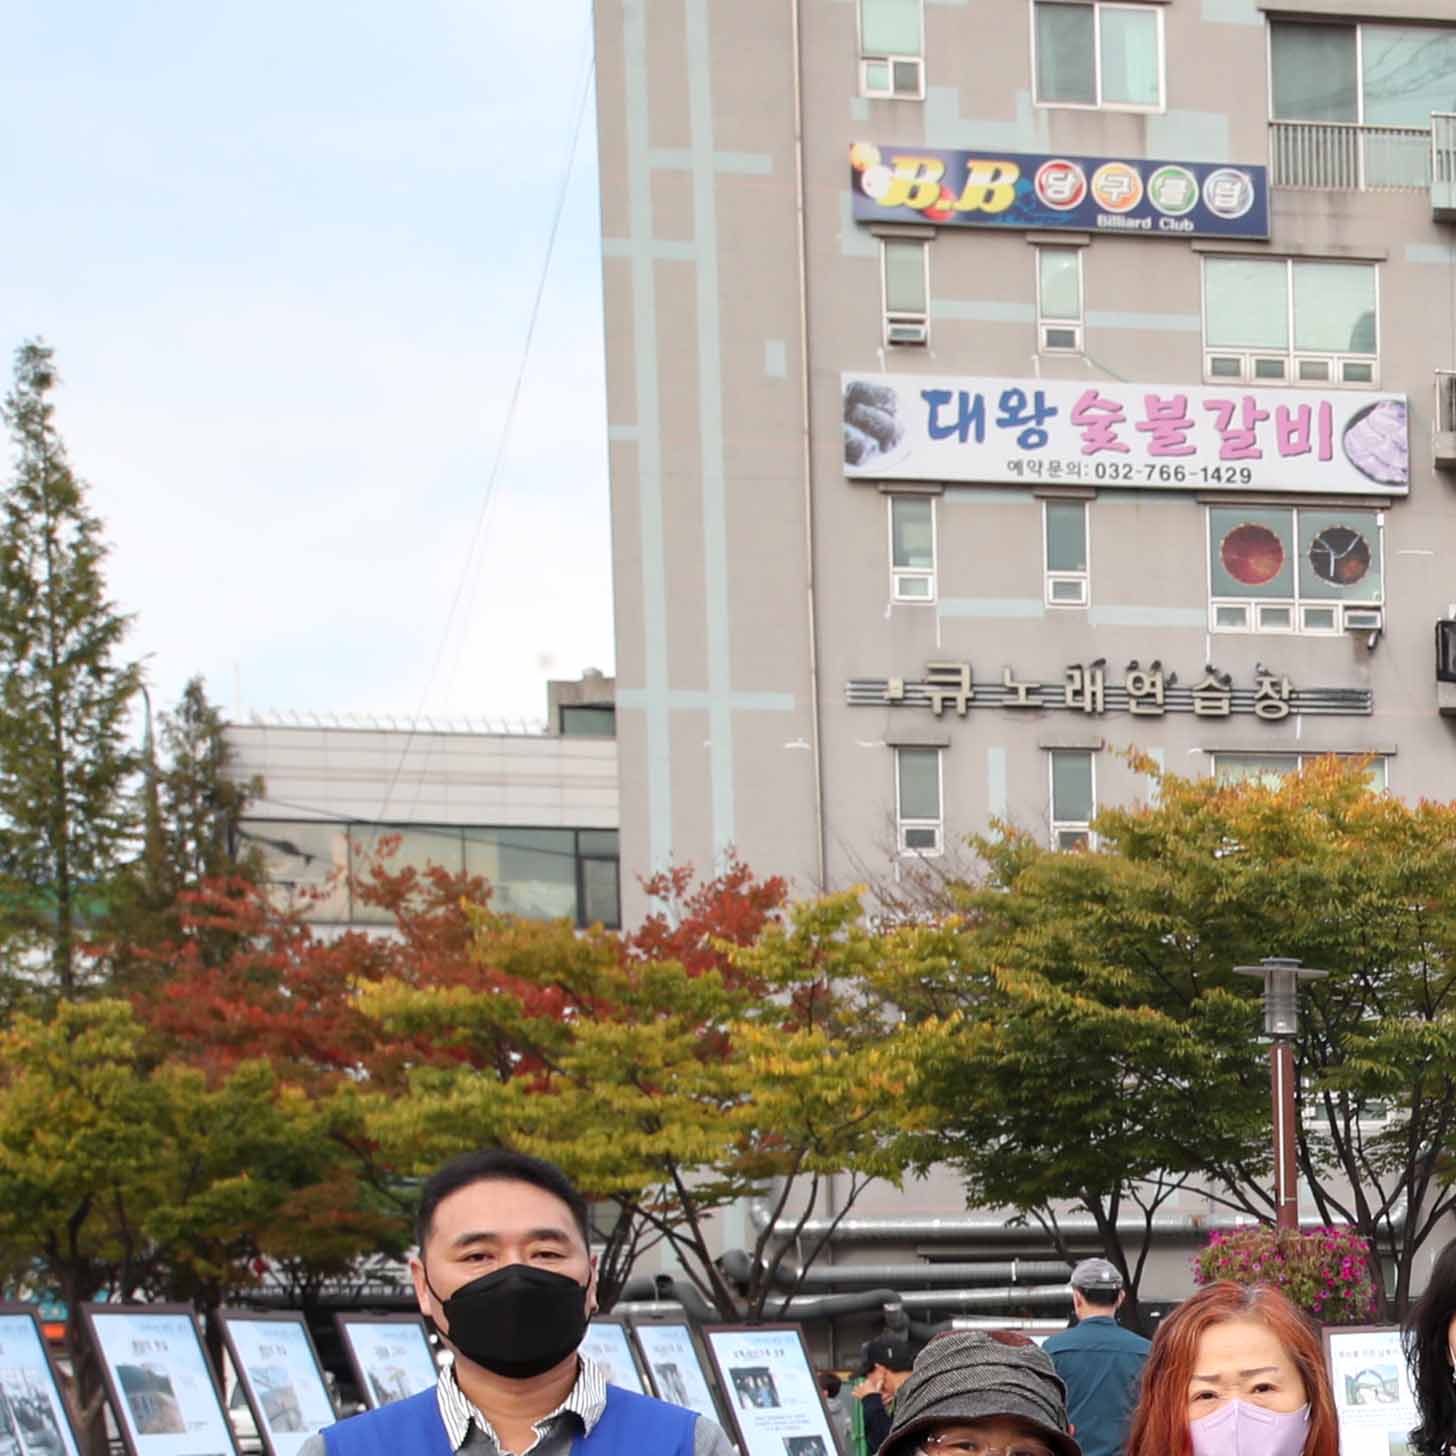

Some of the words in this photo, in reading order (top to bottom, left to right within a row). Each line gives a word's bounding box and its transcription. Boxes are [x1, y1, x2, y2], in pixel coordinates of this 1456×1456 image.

[882, 156, 1020, 212] B.B
[1037, 161, 1252, 215] 당구클럽
[1097, 214, 1152, 230] Billiard
[1159, 217, 1194, 232] Club
[921, 387, 1057, 450] 대왕
[1070, 388, 1334, 461] 숯불갈비
[1007, 460, 1090, 480] 예약문의:
[1095, 462, 1252, 484] 032-766-1429
